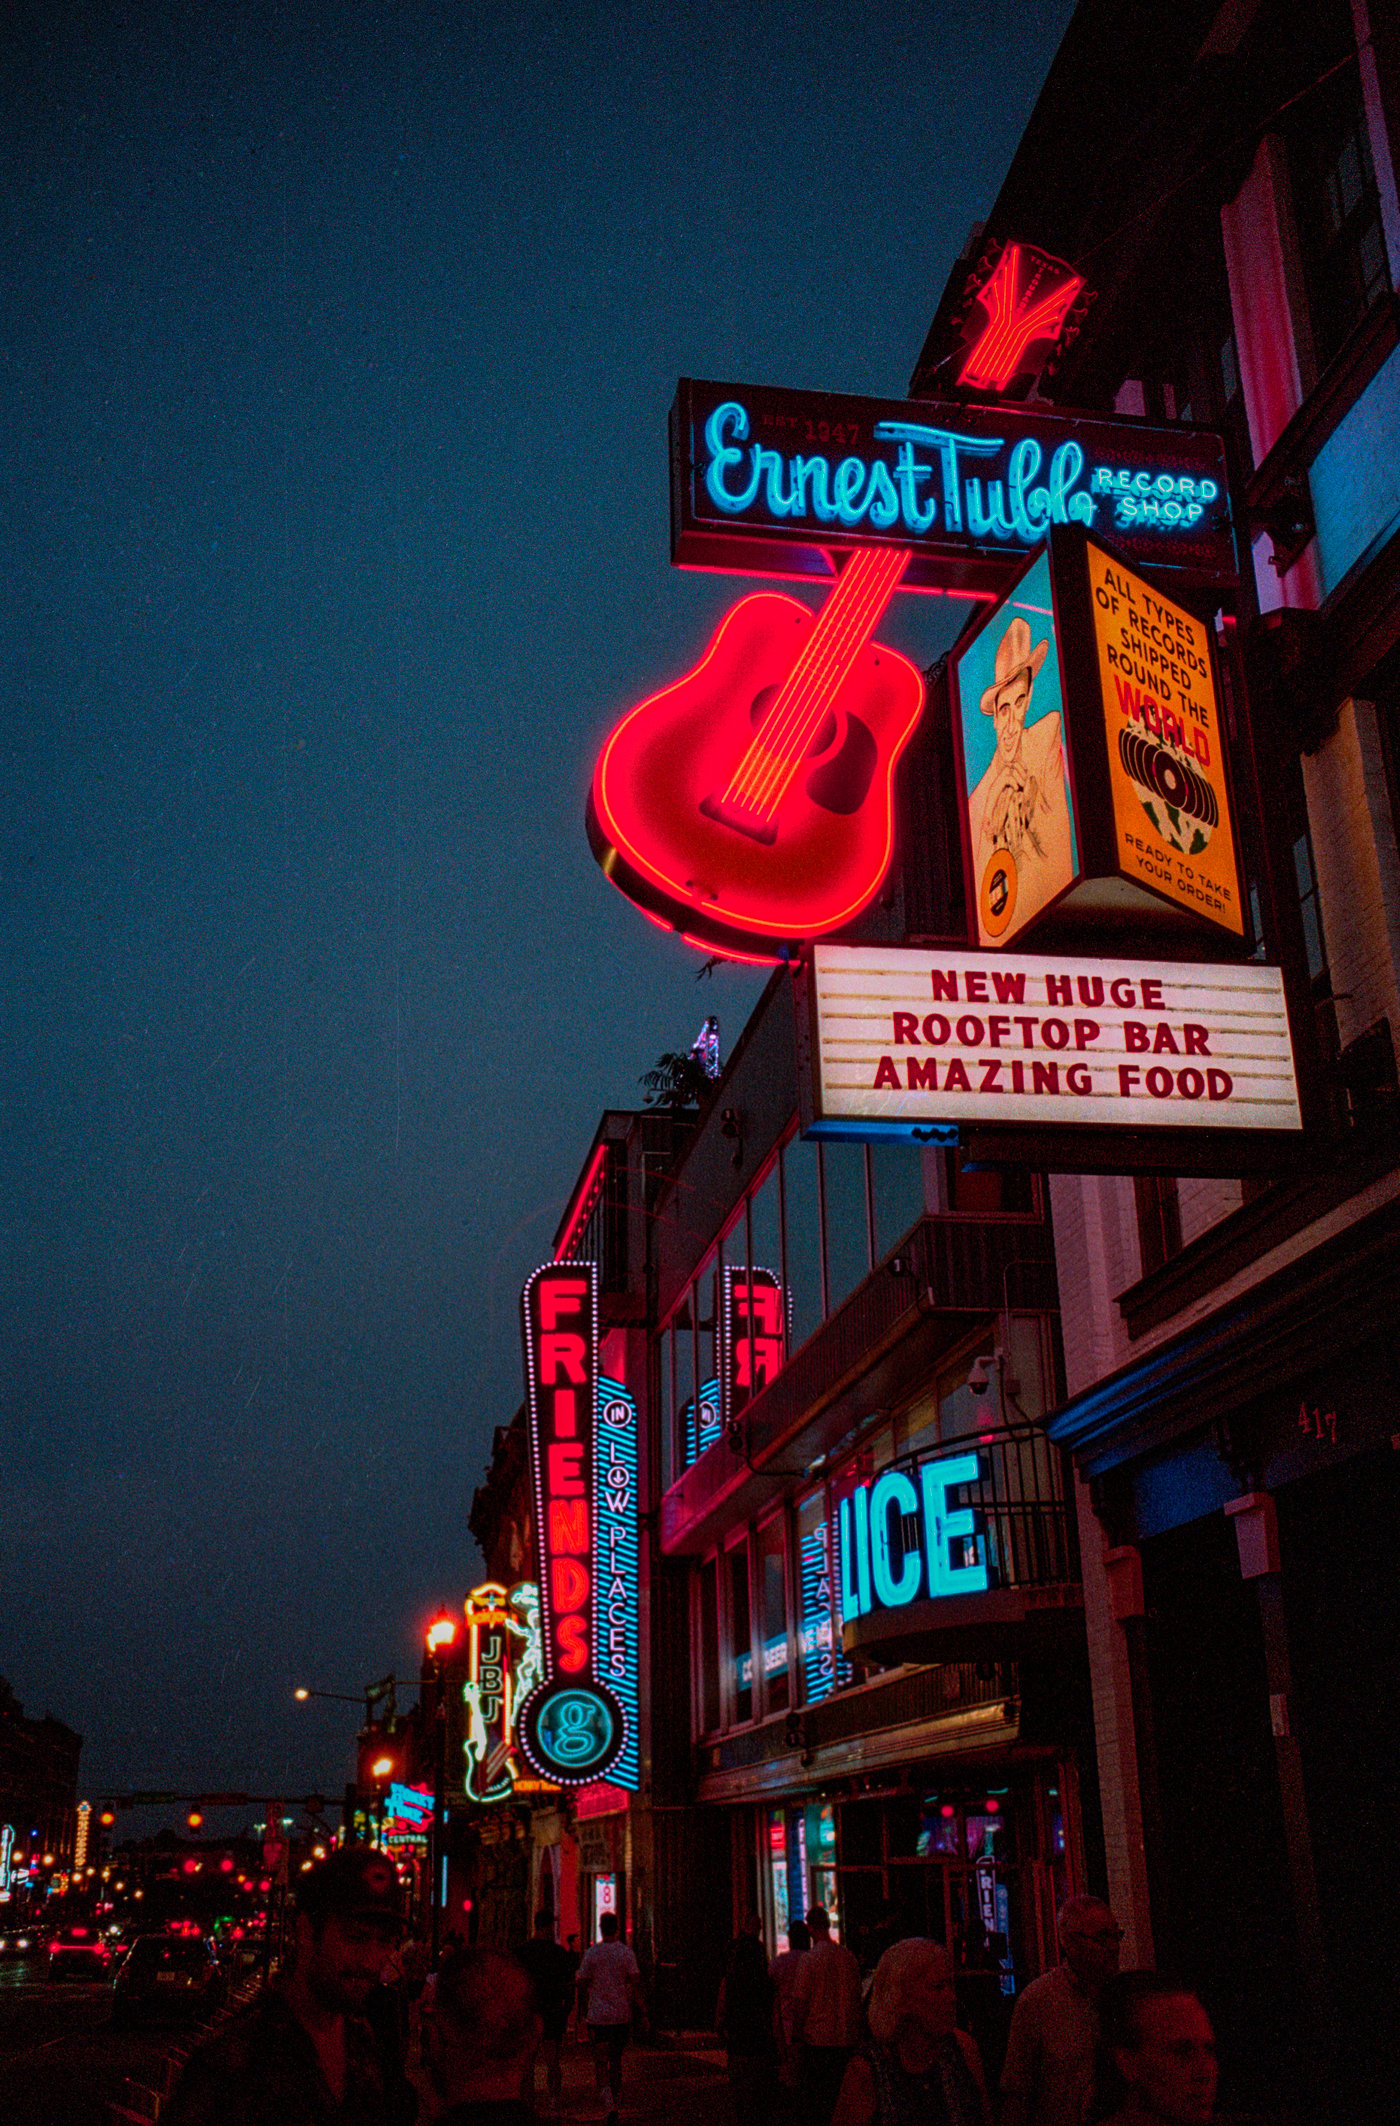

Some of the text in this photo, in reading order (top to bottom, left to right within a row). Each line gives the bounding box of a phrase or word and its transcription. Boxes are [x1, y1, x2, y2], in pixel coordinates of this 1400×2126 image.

[803, 419, 861, 446] 1947
[704, 401, 937, 532] Ernest
[1093, 465, 1219, 499] RECORD
[1117, 495, 1206, 528] SHOP
[1096, 587, 1208, 679] OF RECORDS
[1104, 568, 1196, 646] ALL TYPES
[1107, 644, 1209, 729] ROUND THE
[1120, 627, 1193, 690] SHIPPED
[1113, 674, 1211, 768] WORLD
[1125, 832, 1233, 901] READY TO TAKE
[1135, 855, 1227, 915] YOUR ORDER!
[930, 968, 1166, 1011] NEW HUGE
[892, 1011, 1212, 1056] ROOFTOP BAR
[872, 1055, 1234, 1101] AMAZING FOOD
[609, 1406, 627, 1422] IN
[1297, 1400, 1339, 1445] 417
[538, 1279, 590, 1673] FRIENDS
[606, 1442, 631, 1677] LOW PLACES
[554, 1701, 597, 1758] g
[387, 1833, 430, 1845] CENTRAL
